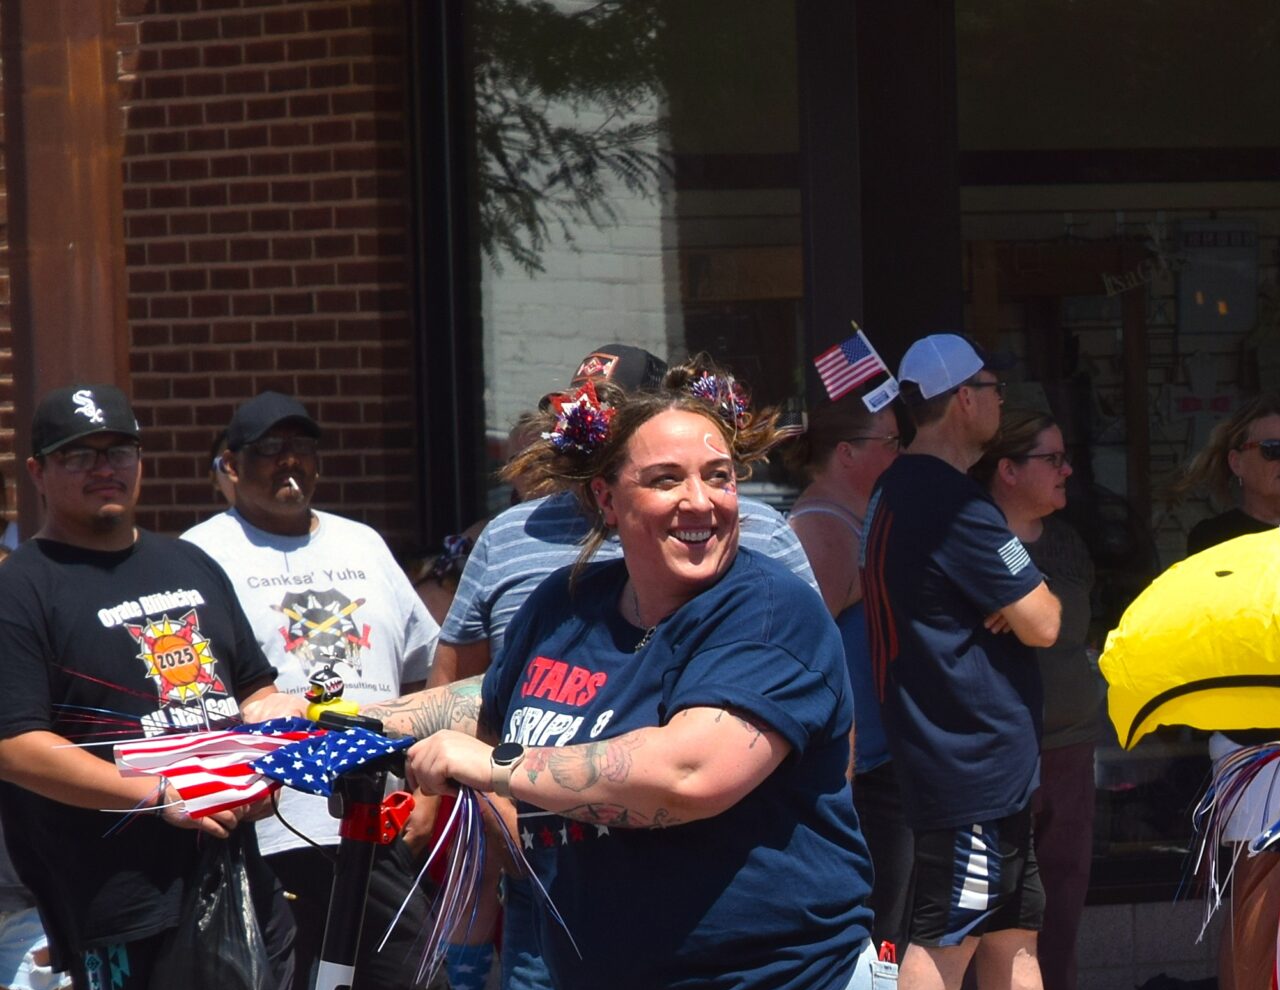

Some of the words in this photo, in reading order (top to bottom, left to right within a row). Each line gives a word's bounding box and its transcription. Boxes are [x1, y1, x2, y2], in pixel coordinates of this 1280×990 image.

[323, 568, 366, 582] Yuha
[97, 601, 143, 628] Oyate
[157, 648, 194, 669] 2025
